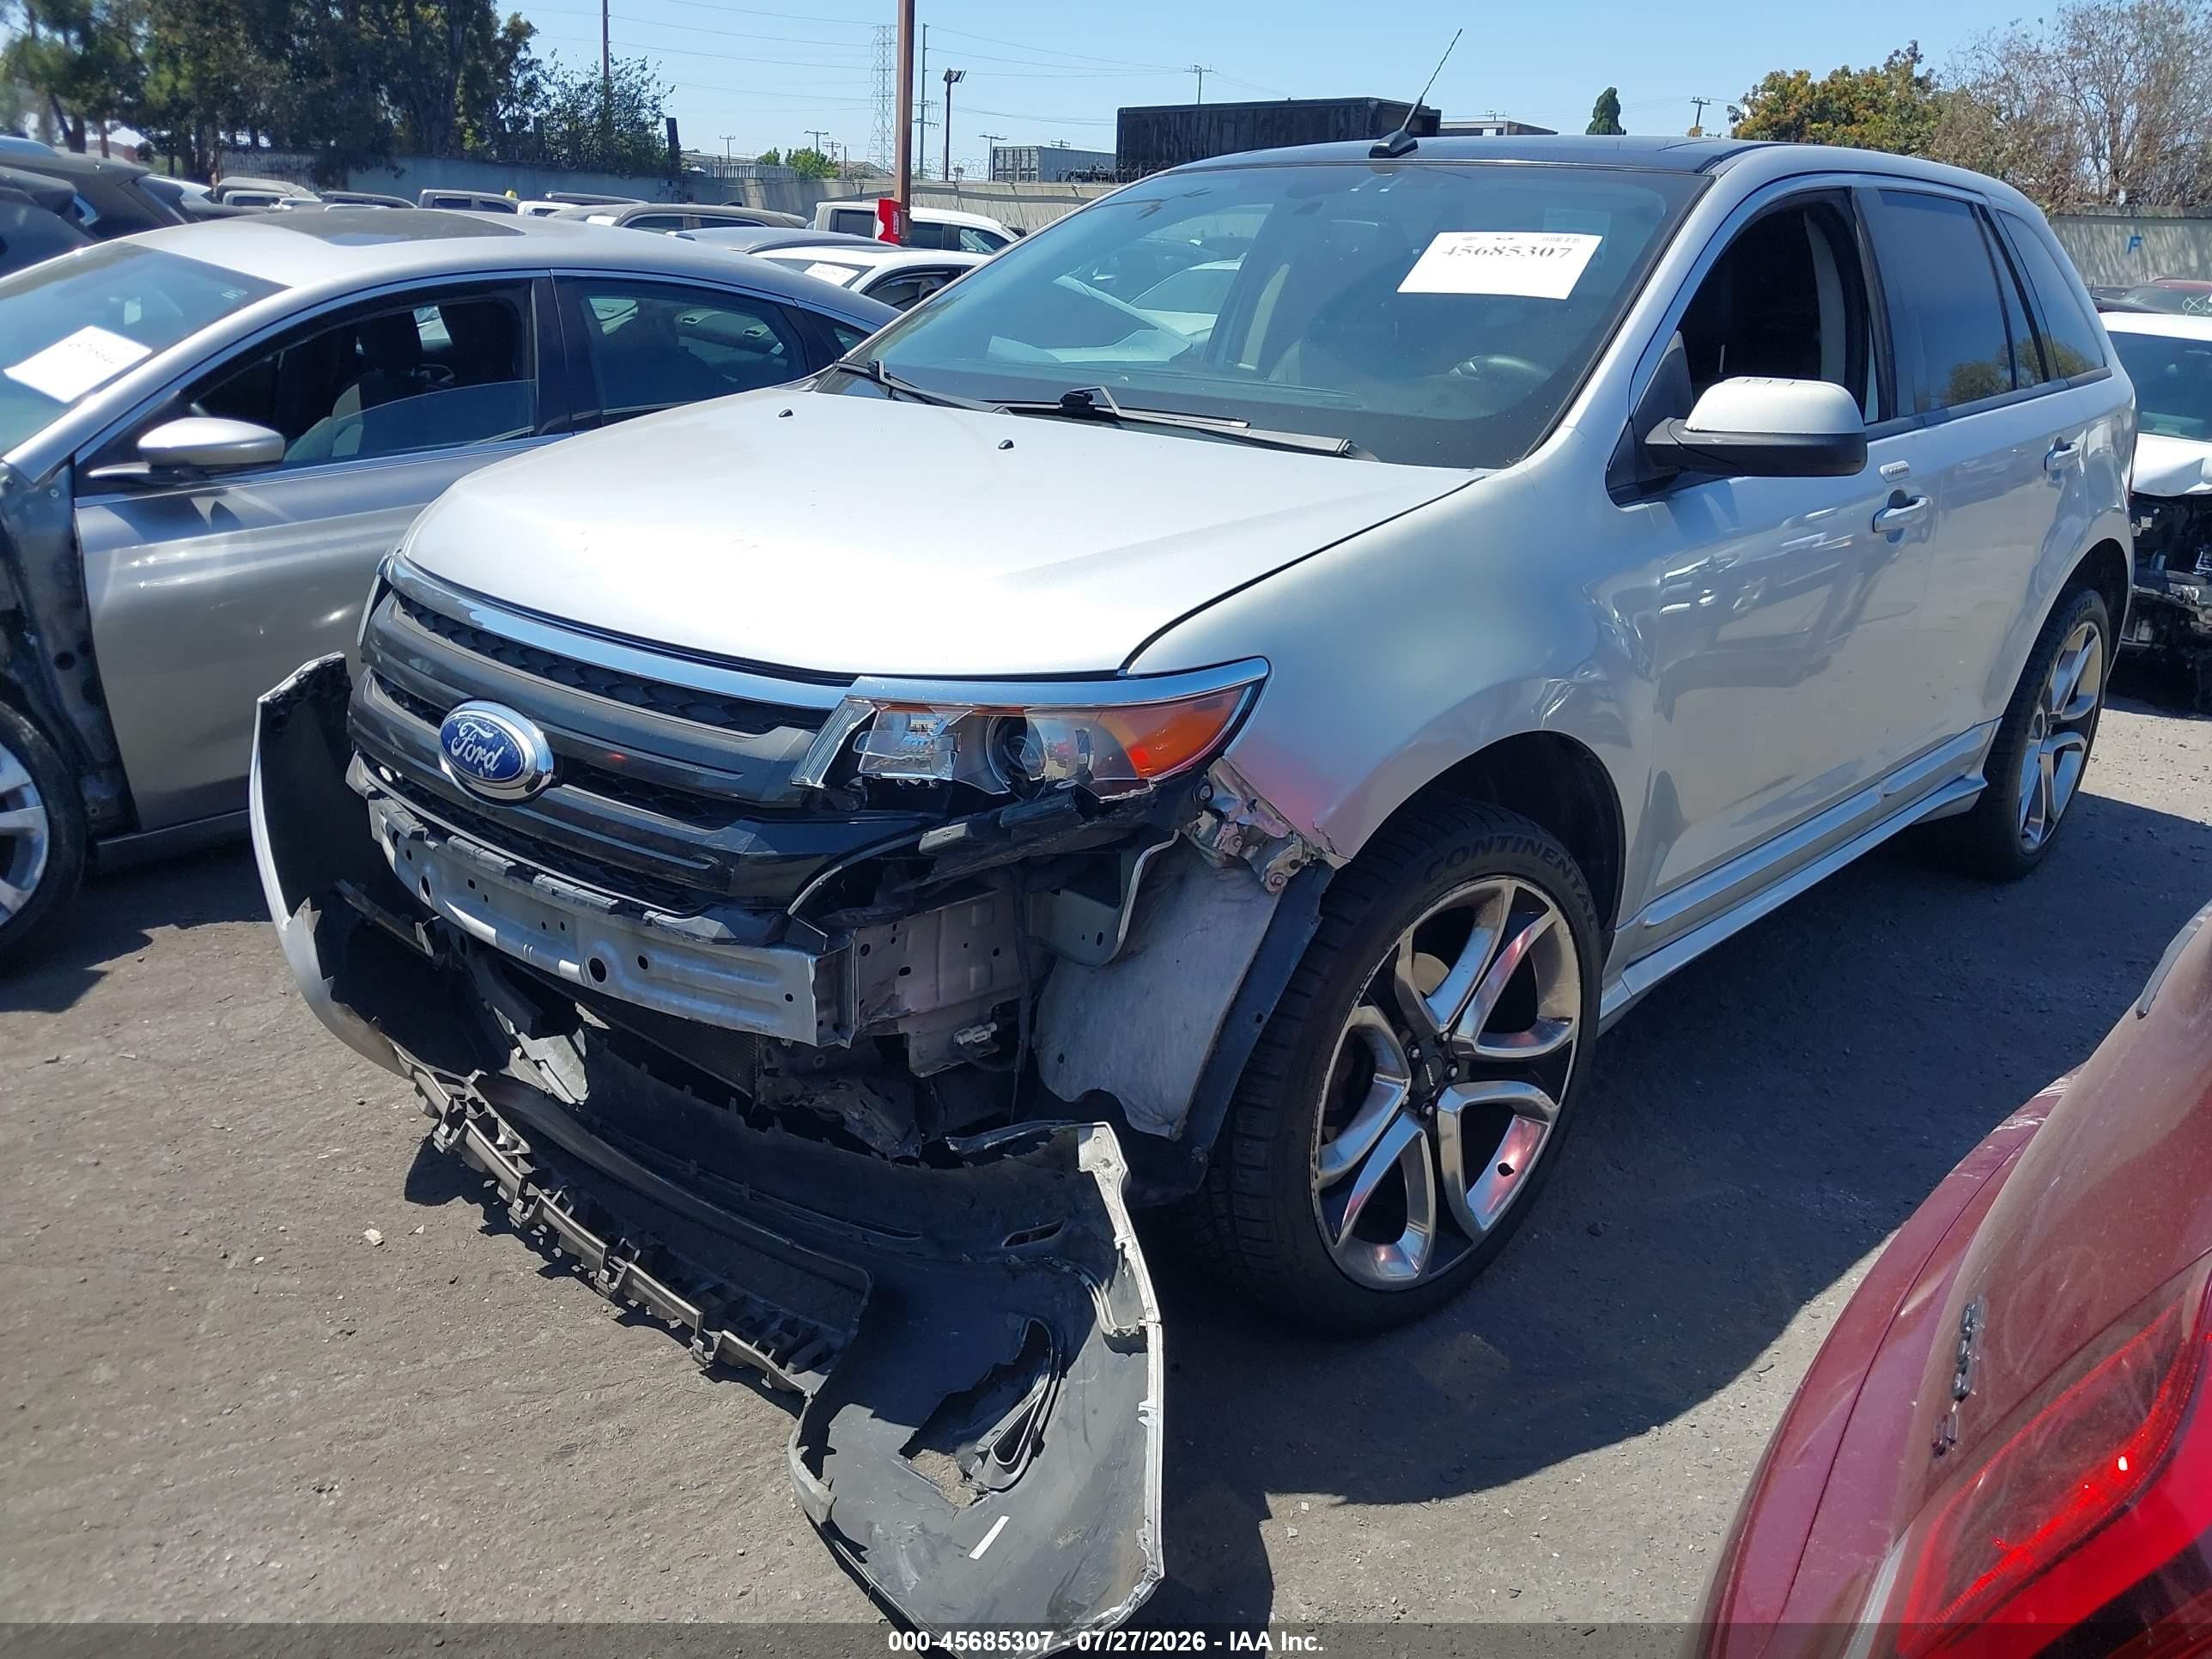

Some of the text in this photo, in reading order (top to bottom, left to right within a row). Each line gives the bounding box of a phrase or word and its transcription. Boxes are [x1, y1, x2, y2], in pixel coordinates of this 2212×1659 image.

[1443, 245, 1573, 258] 45685307
[451, 721, 504, 772] Ford
[1425, 836, 1595, 931] CONTINENTAL
